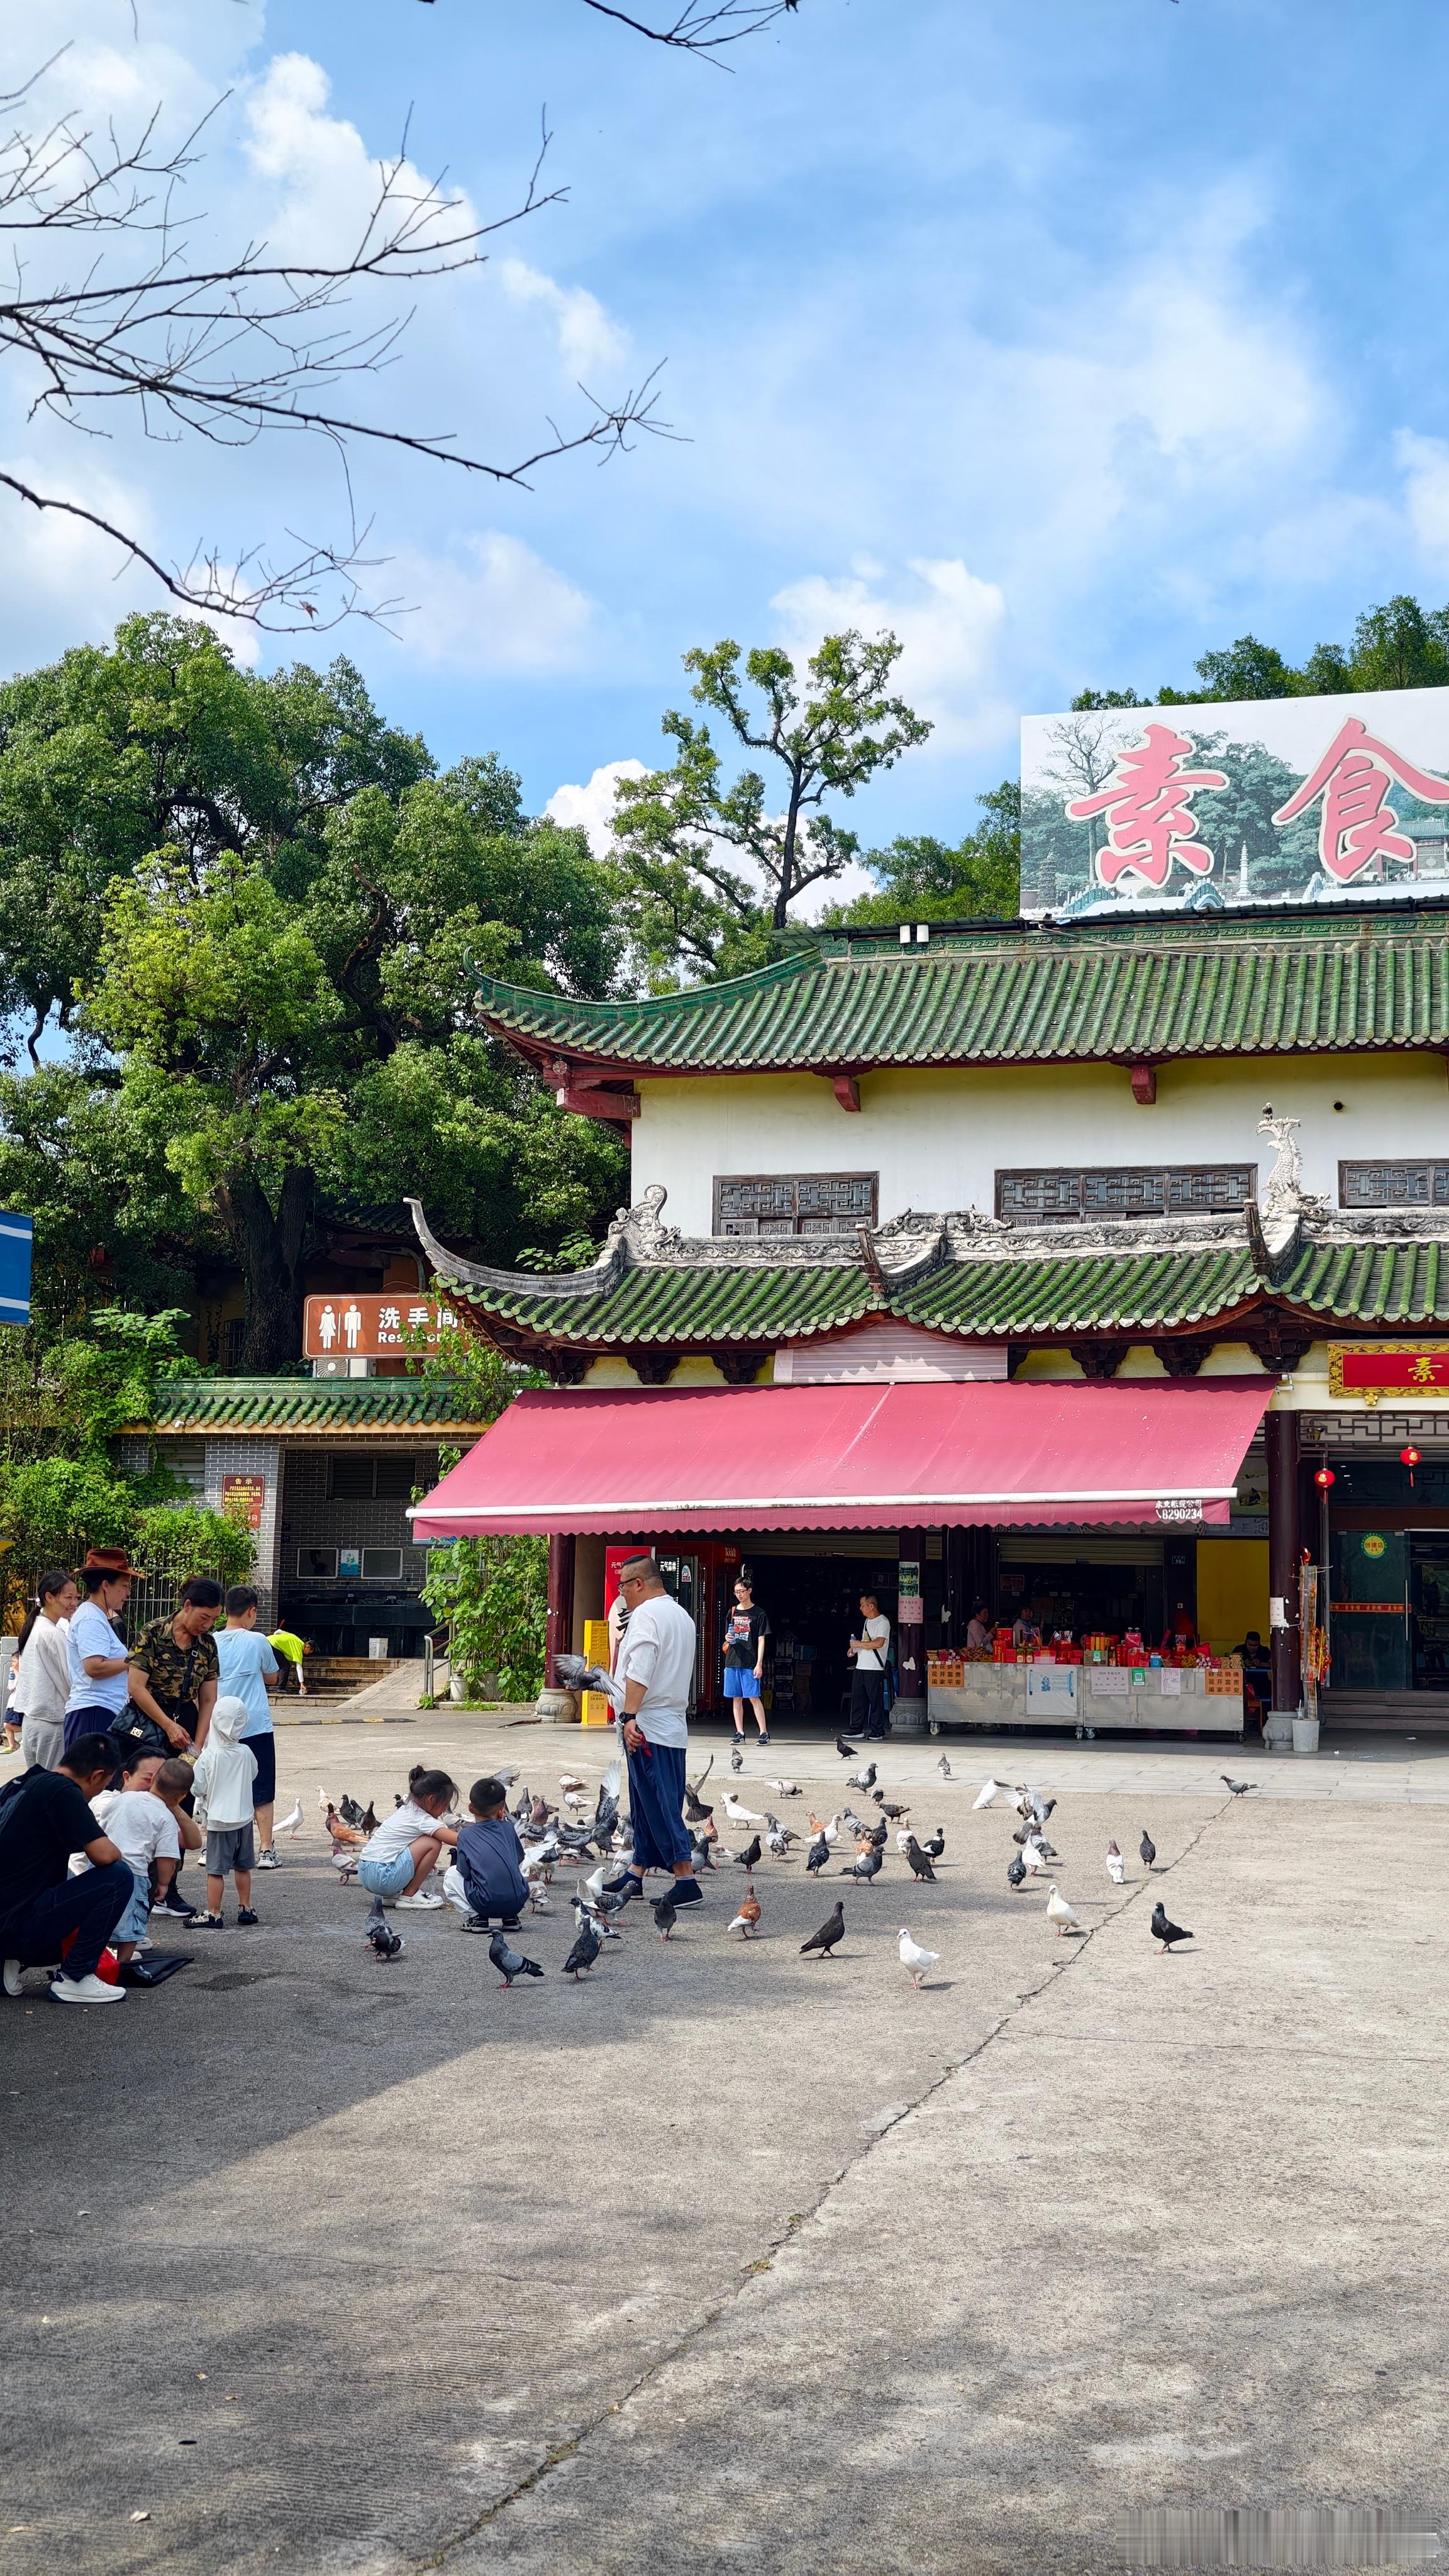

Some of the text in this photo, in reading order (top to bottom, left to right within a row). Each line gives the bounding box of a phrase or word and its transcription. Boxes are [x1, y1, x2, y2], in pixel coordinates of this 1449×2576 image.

[1065, 714, 1449, 889] 素食
[379, 1307, 458, 1329] 洗手间
[1407, 1357, 1443, 1382] 素
[1162, 1508, 1202, 1519] 8290234
[660, 1561, 676, 1572] 元气森林
